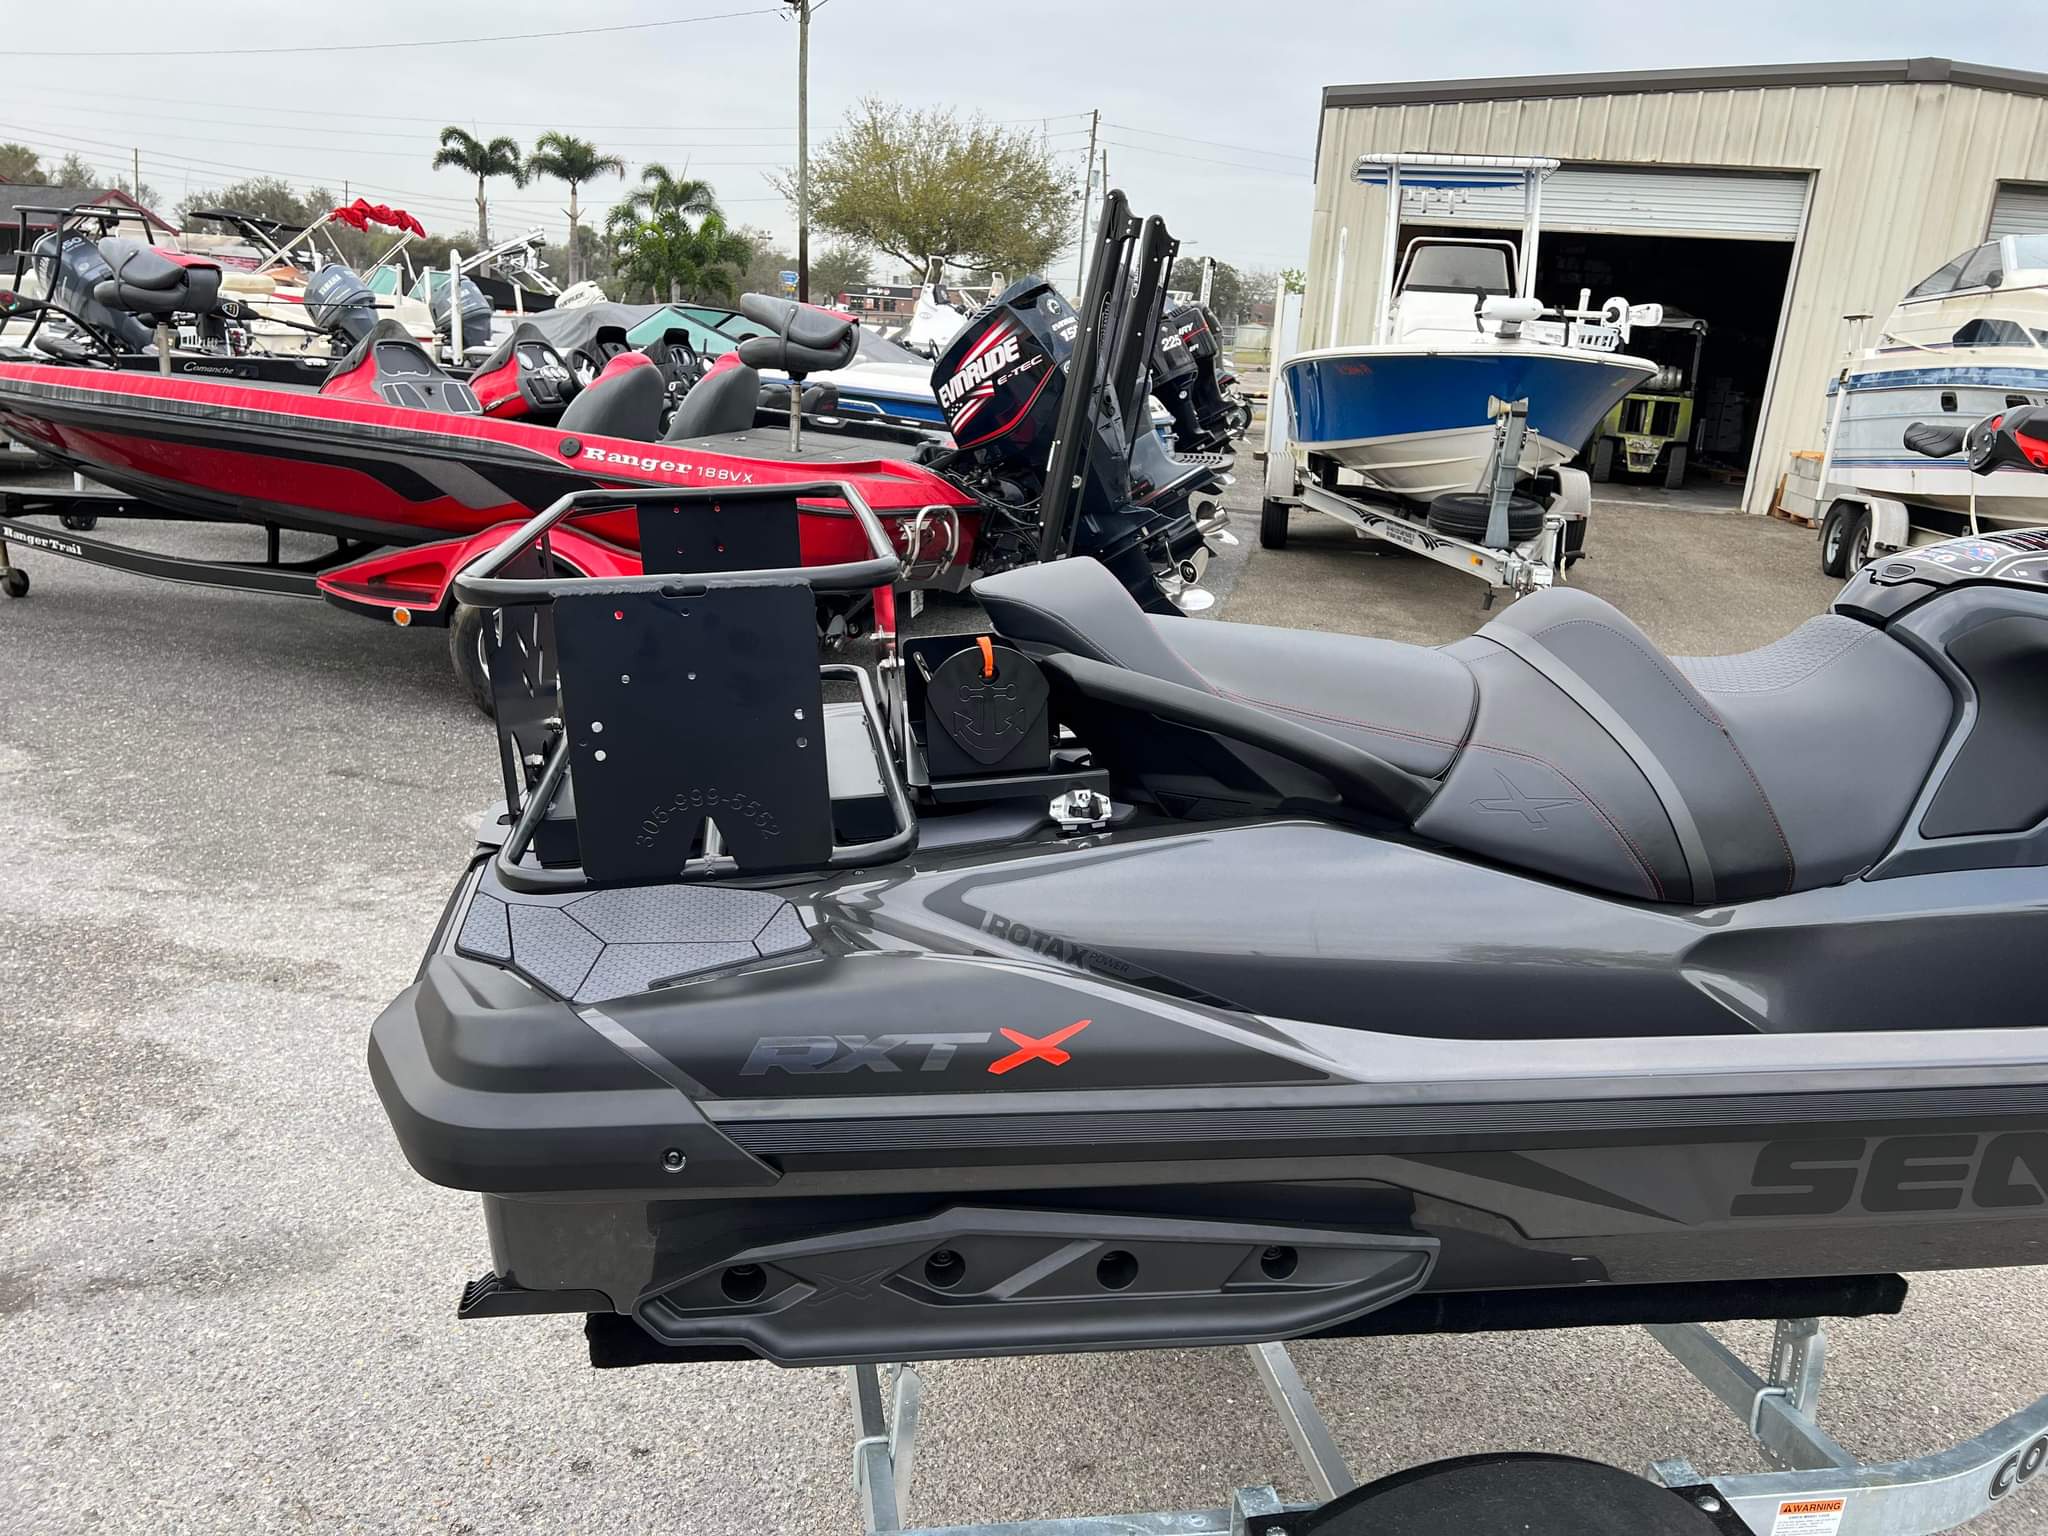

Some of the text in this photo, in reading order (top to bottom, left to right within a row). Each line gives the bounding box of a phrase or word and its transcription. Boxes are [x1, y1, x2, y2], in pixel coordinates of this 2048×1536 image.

[1161, 334, 1182, 351] 225
[183, 361, 235, 374] Comanche
[938, 335, 1043, 408] EVINRUDE E-TEC
[583, 447, 753, 484] Ranger 188VX
[986, 913, 1131, 974] ROTAX POWER
[739, 1032, 992, 1076] RXT
[1793, 1502, 1841, 1513] WARNING
